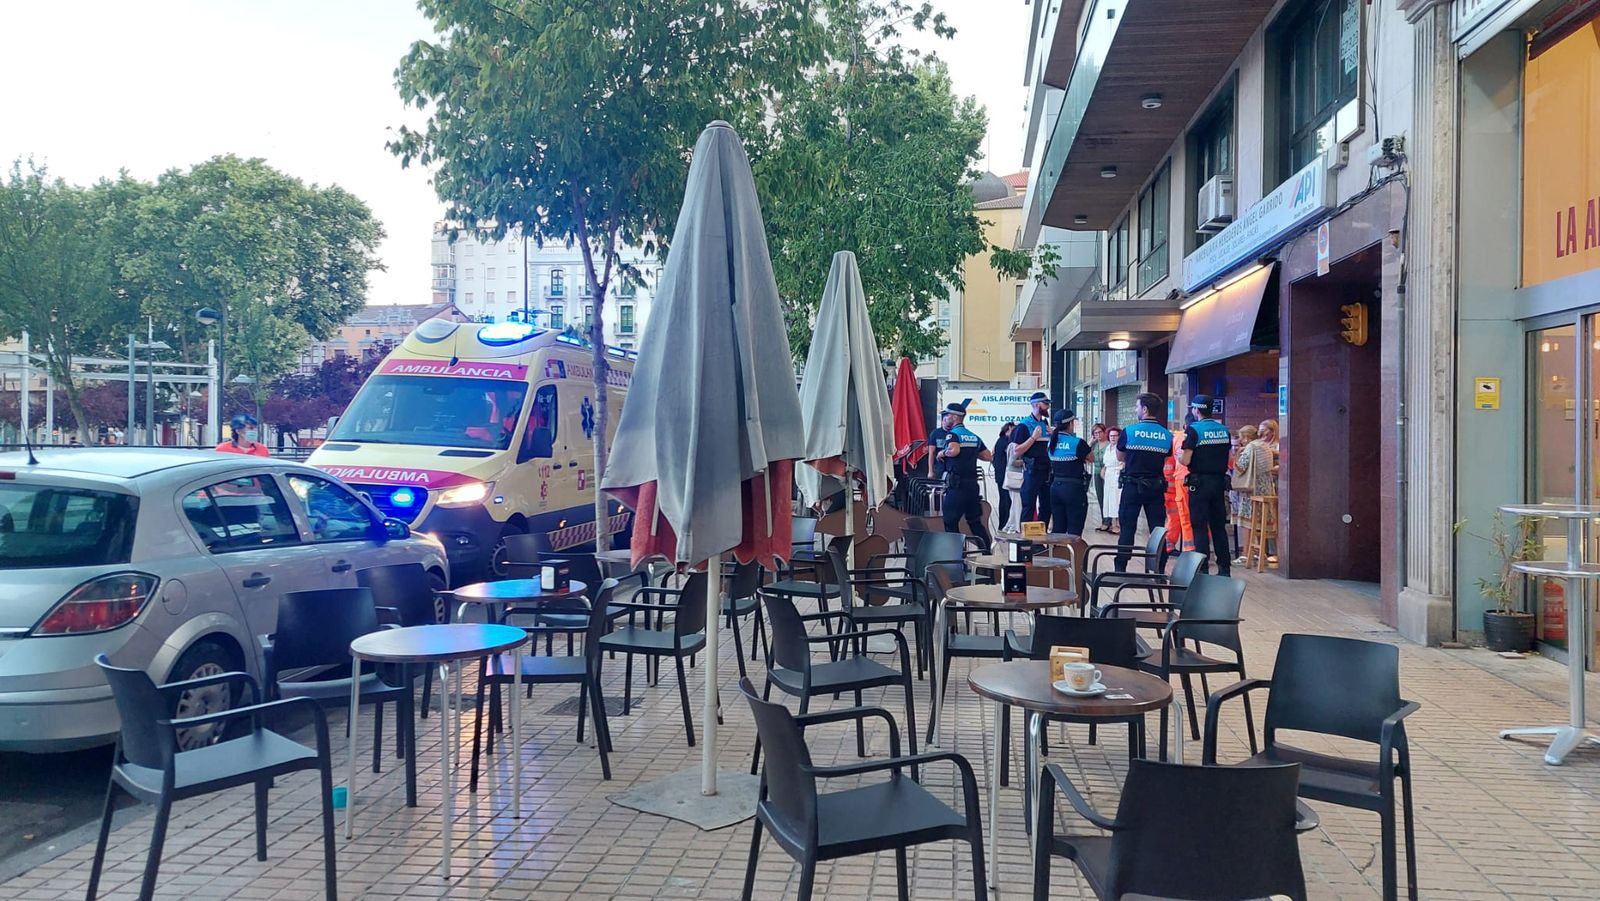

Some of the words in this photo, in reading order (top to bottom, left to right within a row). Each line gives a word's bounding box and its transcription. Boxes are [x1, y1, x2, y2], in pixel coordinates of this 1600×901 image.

[1294, 166, 1316, 208] API
[1258, 192, 1282, 218] GARRIDO
[1557, 206, 1577, 258] LA
[391, 364, 513, 379] AMBULANCIA
